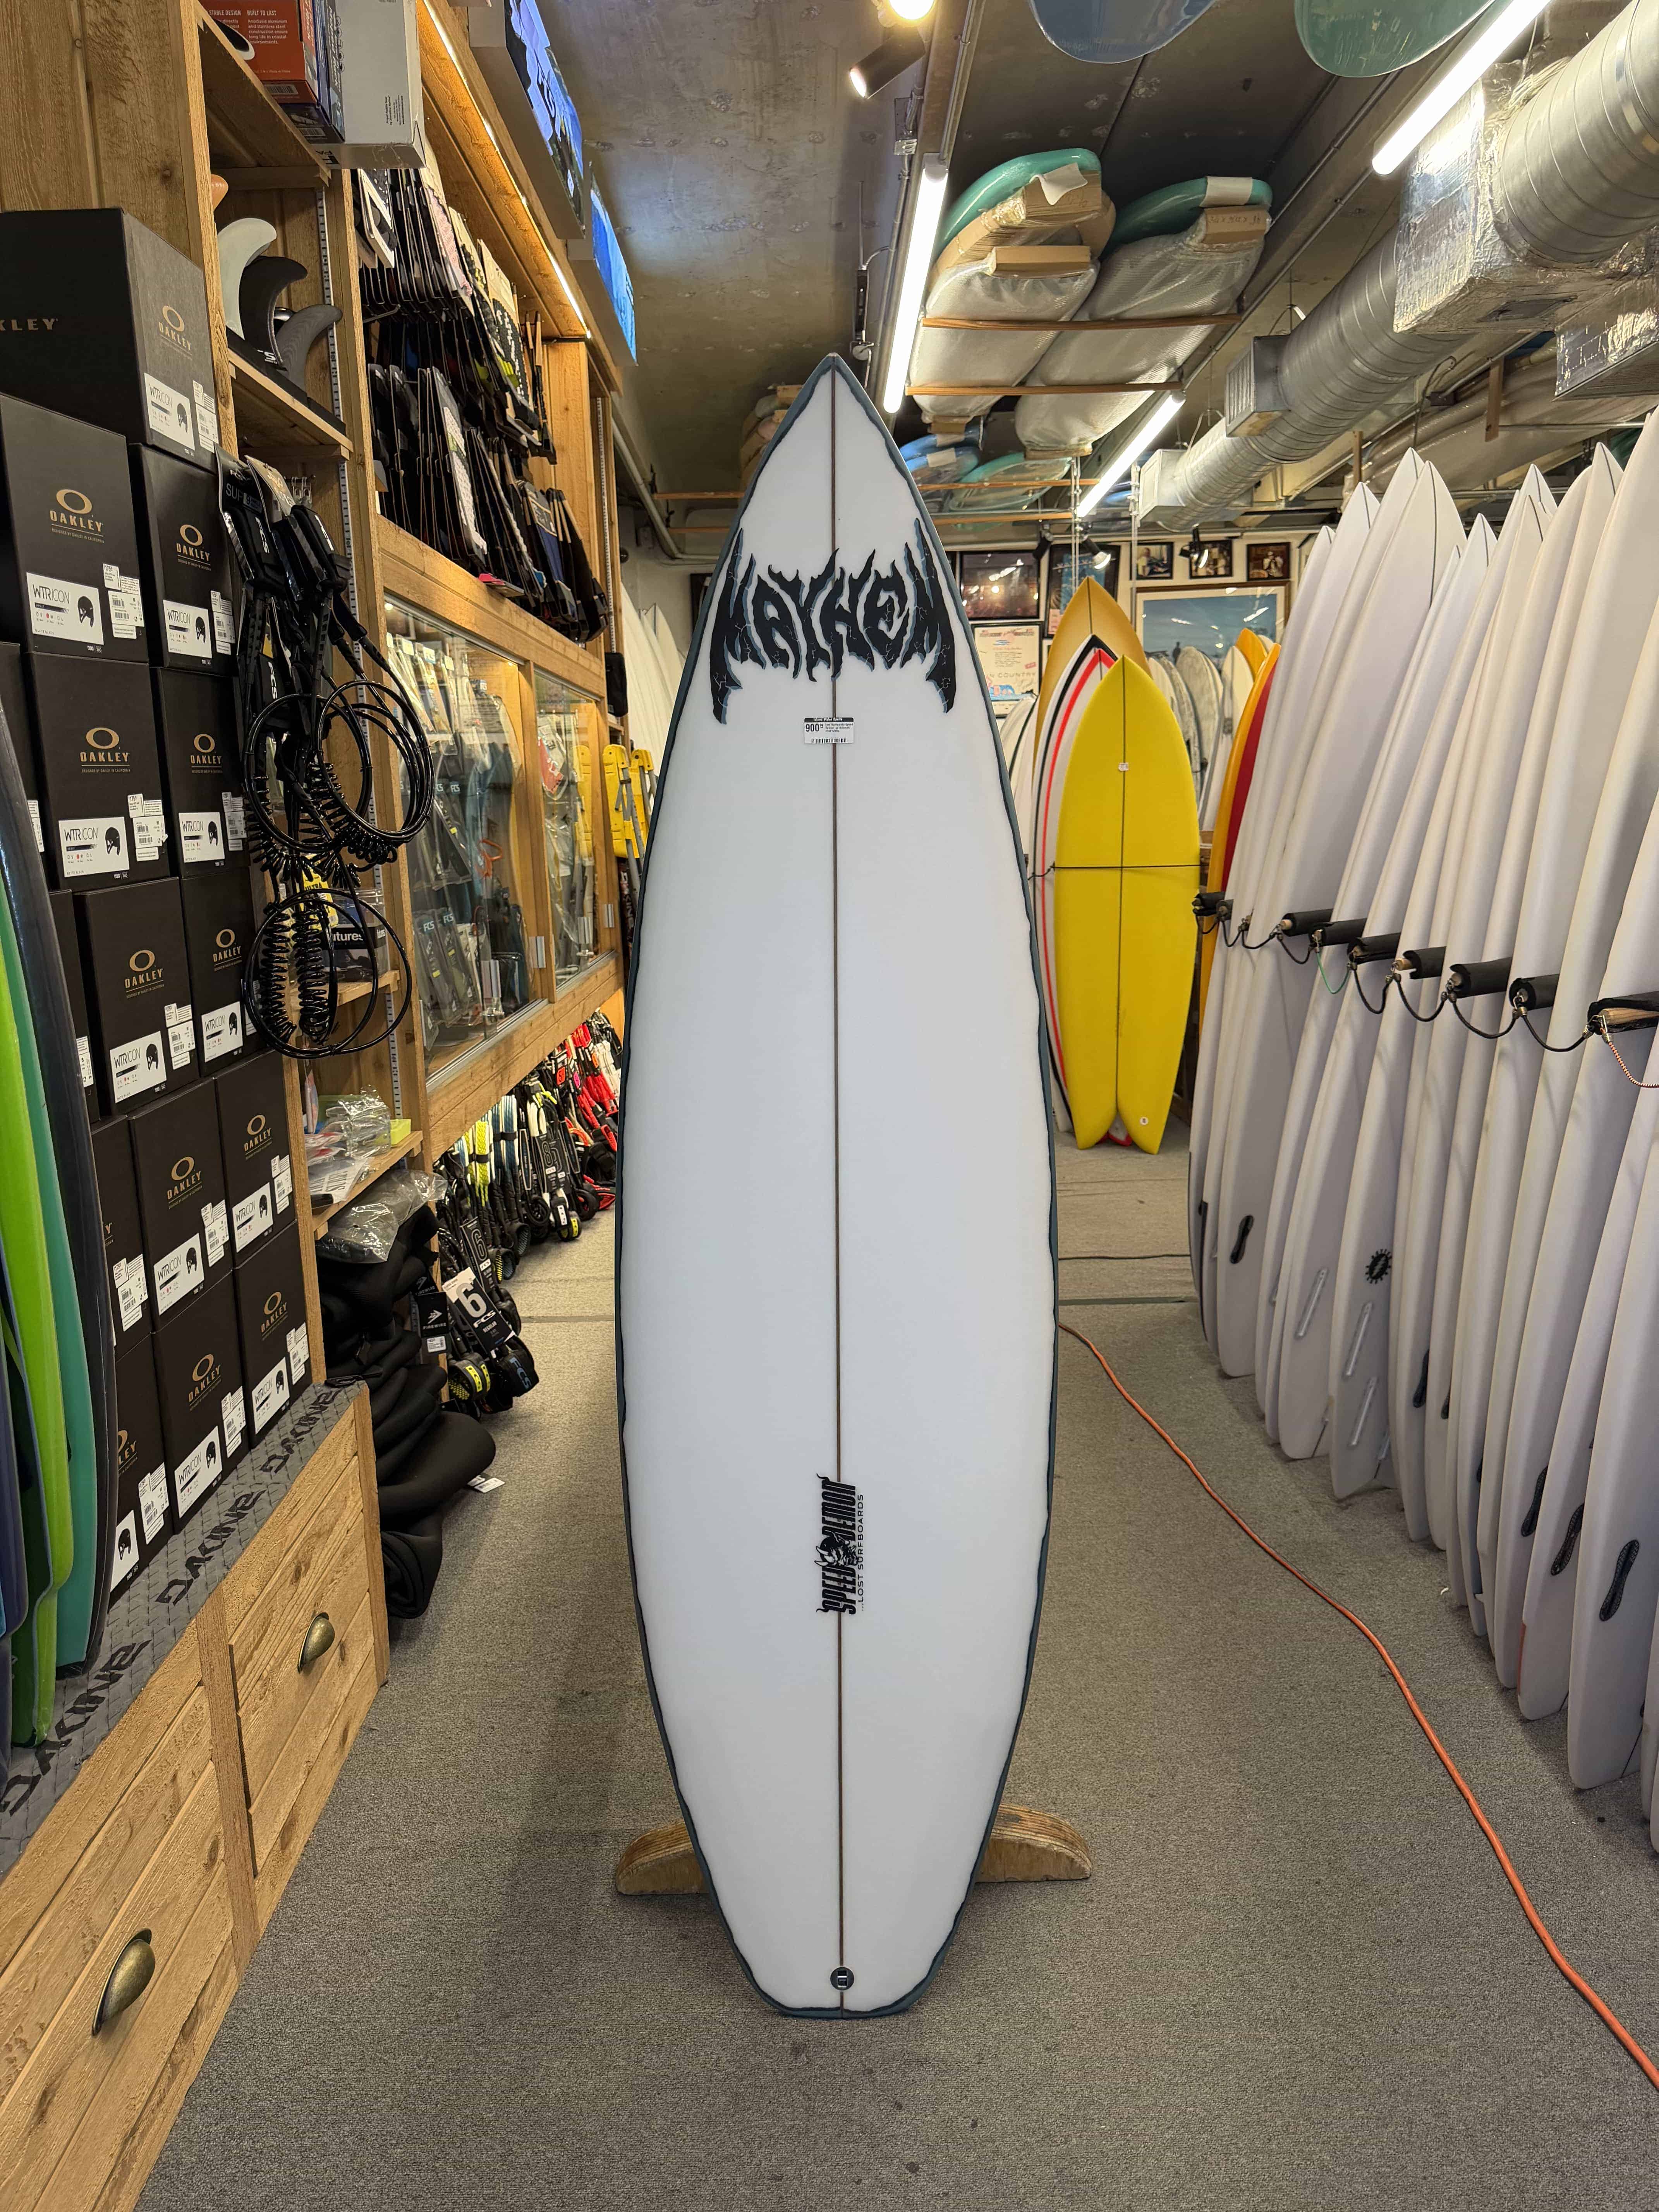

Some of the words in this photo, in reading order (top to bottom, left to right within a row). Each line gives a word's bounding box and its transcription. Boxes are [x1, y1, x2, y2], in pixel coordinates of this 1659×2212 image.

[159, 322, 192, 350] OAKLEY
[226, 483, 243, 502] SUP
[50, 510, 103, 532] OAKLEY
[255, 516, 270, 554] FCS
[177, 543, 210, 561] OAKLEY
[33, 584, 70, 605] WTRICON
[167, 608, 191, 625] WTRICON
[710, 518, 956, 725] MAYHEM
[268, 661, 278, 699] FCS
[805, 723, 819, 732] 900
[80, 752, 130, 763] OAKLEY
[191, 755, 222, 764] OAKLEY
[450, 784, 460, 792] FCS
[64, 827, 98, 841] WTRICON
[182, 821, 204, 833] WTRICON
[423, 921, 434, 932] FCS
[443, 913, 453, 924] FCS
[332, 932, 363, 941] utures
[213, 946, 241, 962] OAKLEY
[124, 969, 163, 988] OAKLEY
[205, 1015, 225, 1032] WTRICON
[114, 1048, 141, 1068] WTRICON
[244, 1128, 271, 1152] OAKLEY
[167, 1170, 202, 1200] OAKLEY
[235, 1200, 256, 1223] WTRICON
[471, 1229, 487, 1261] 6
[157, 1254, 182, 1281] WTRICON
[456, 1283, 487, 1318] 6
[261, 1302, 287, 1333] OAKLEY
[473, 1310, 496, 1329] FCS
[189, 1364, 222, 1403] OAKLEY
[508, 1357, 532, 1389] FCS
[118, 1440, 137, 1466] LEY
[179, 1451, 202, 1485] WTRICON
[816, 1472, 857, 1541] DEMON
[155, 1489, 268, 1606] DAKINE
[816, 1565, 857, 1615] SPEED
[0, 1639, 153, 1817] DAKINE
